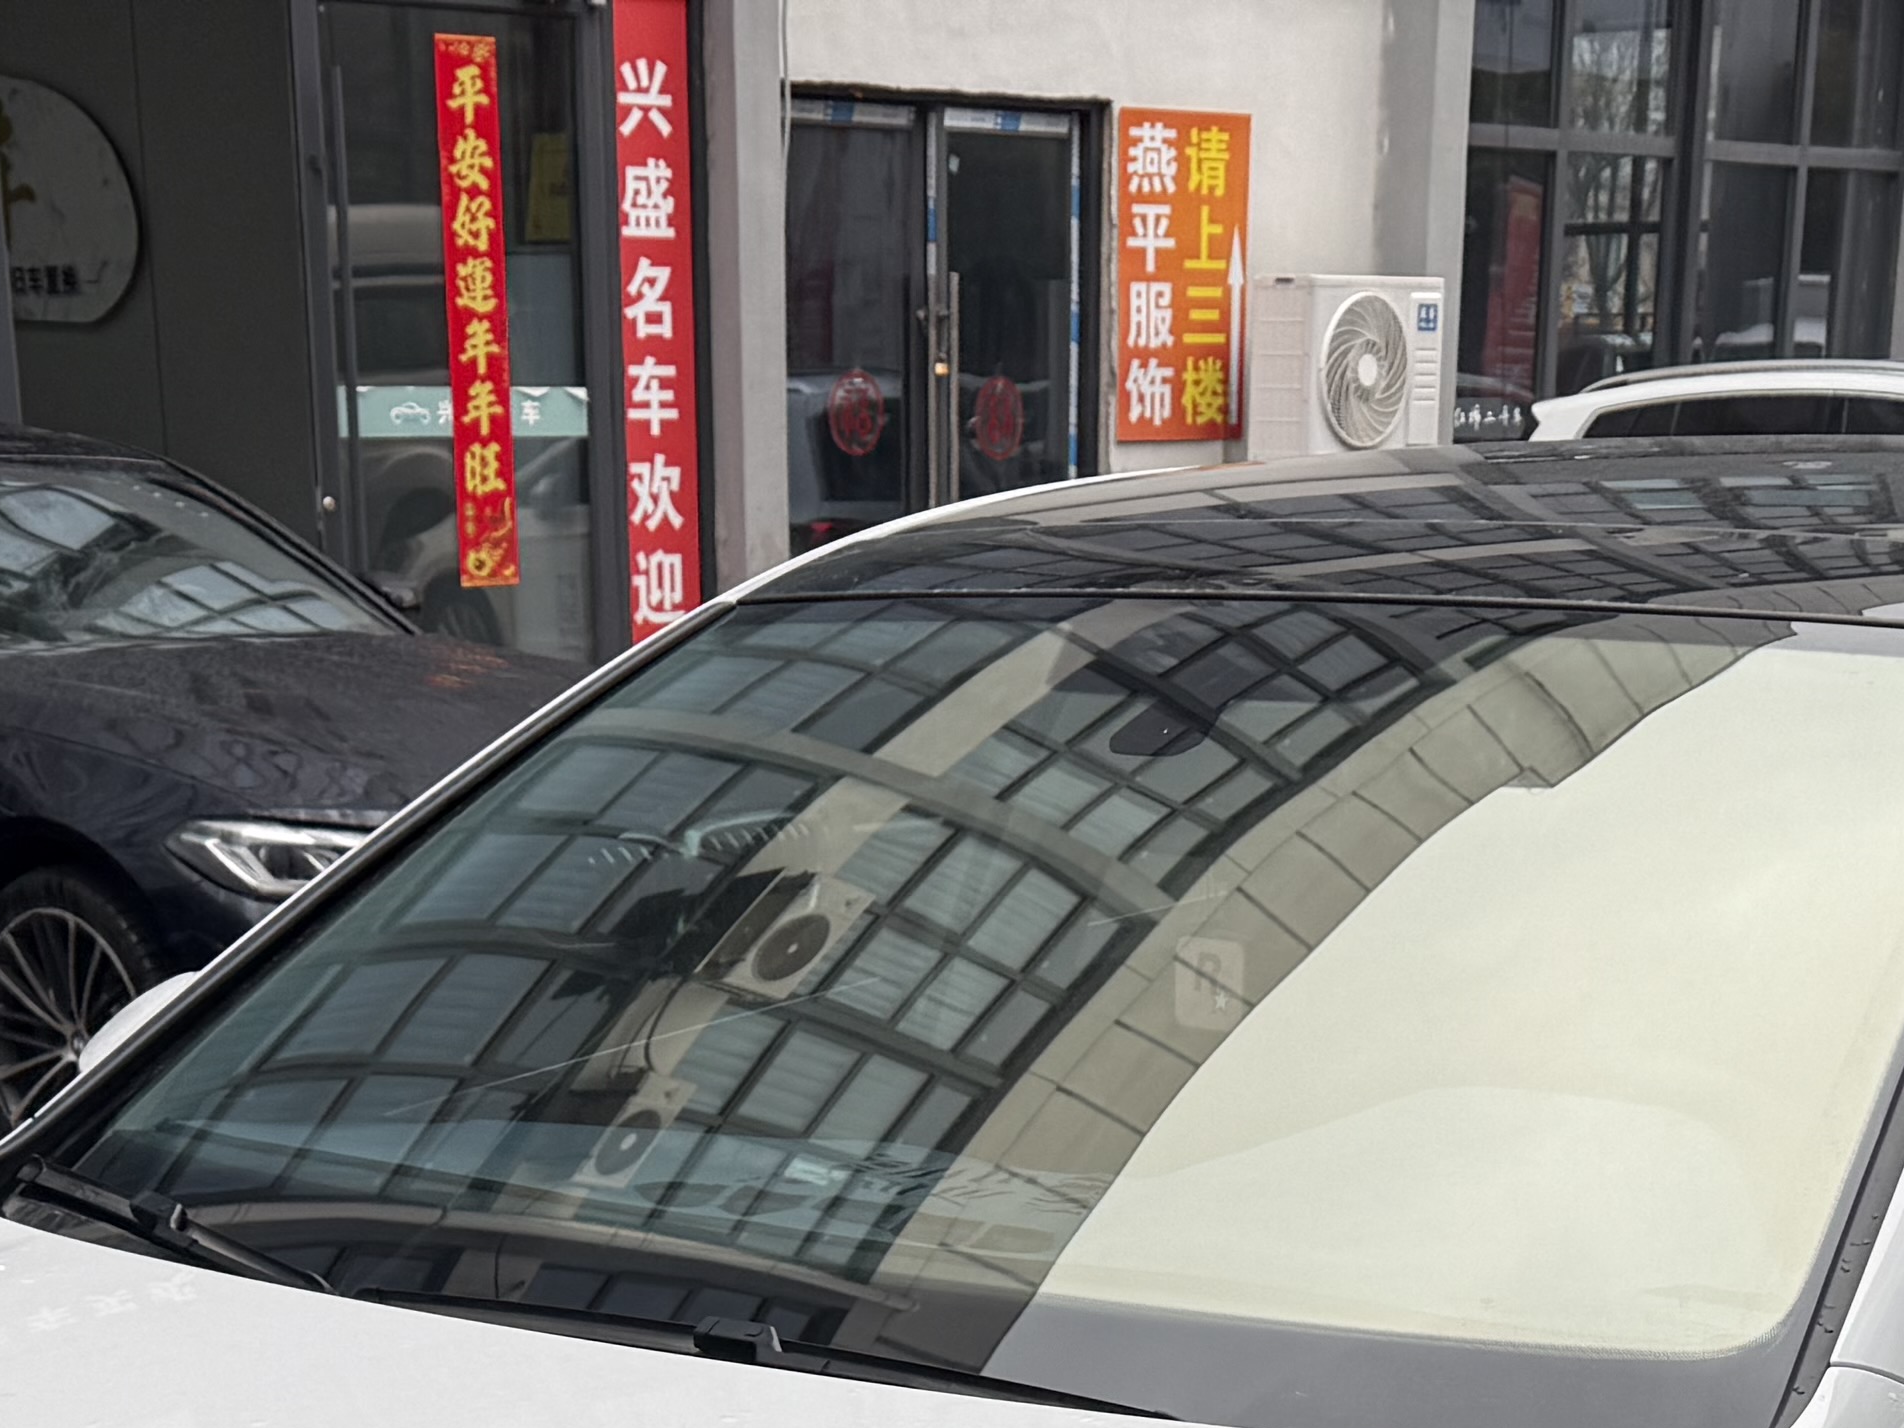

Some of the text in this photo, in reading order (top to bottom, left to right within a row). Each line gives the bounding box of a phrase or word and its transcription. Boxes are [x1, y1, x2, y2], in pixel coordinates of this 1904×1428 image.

[445, 65, 507, 496] 平安好運年年旺
[617, 57, 686, 627] 兴盛名车欢迎
[1126, 121, 1177, 428] 燕平服饰
[1181, 126, 1229, 427] 请上三楼
